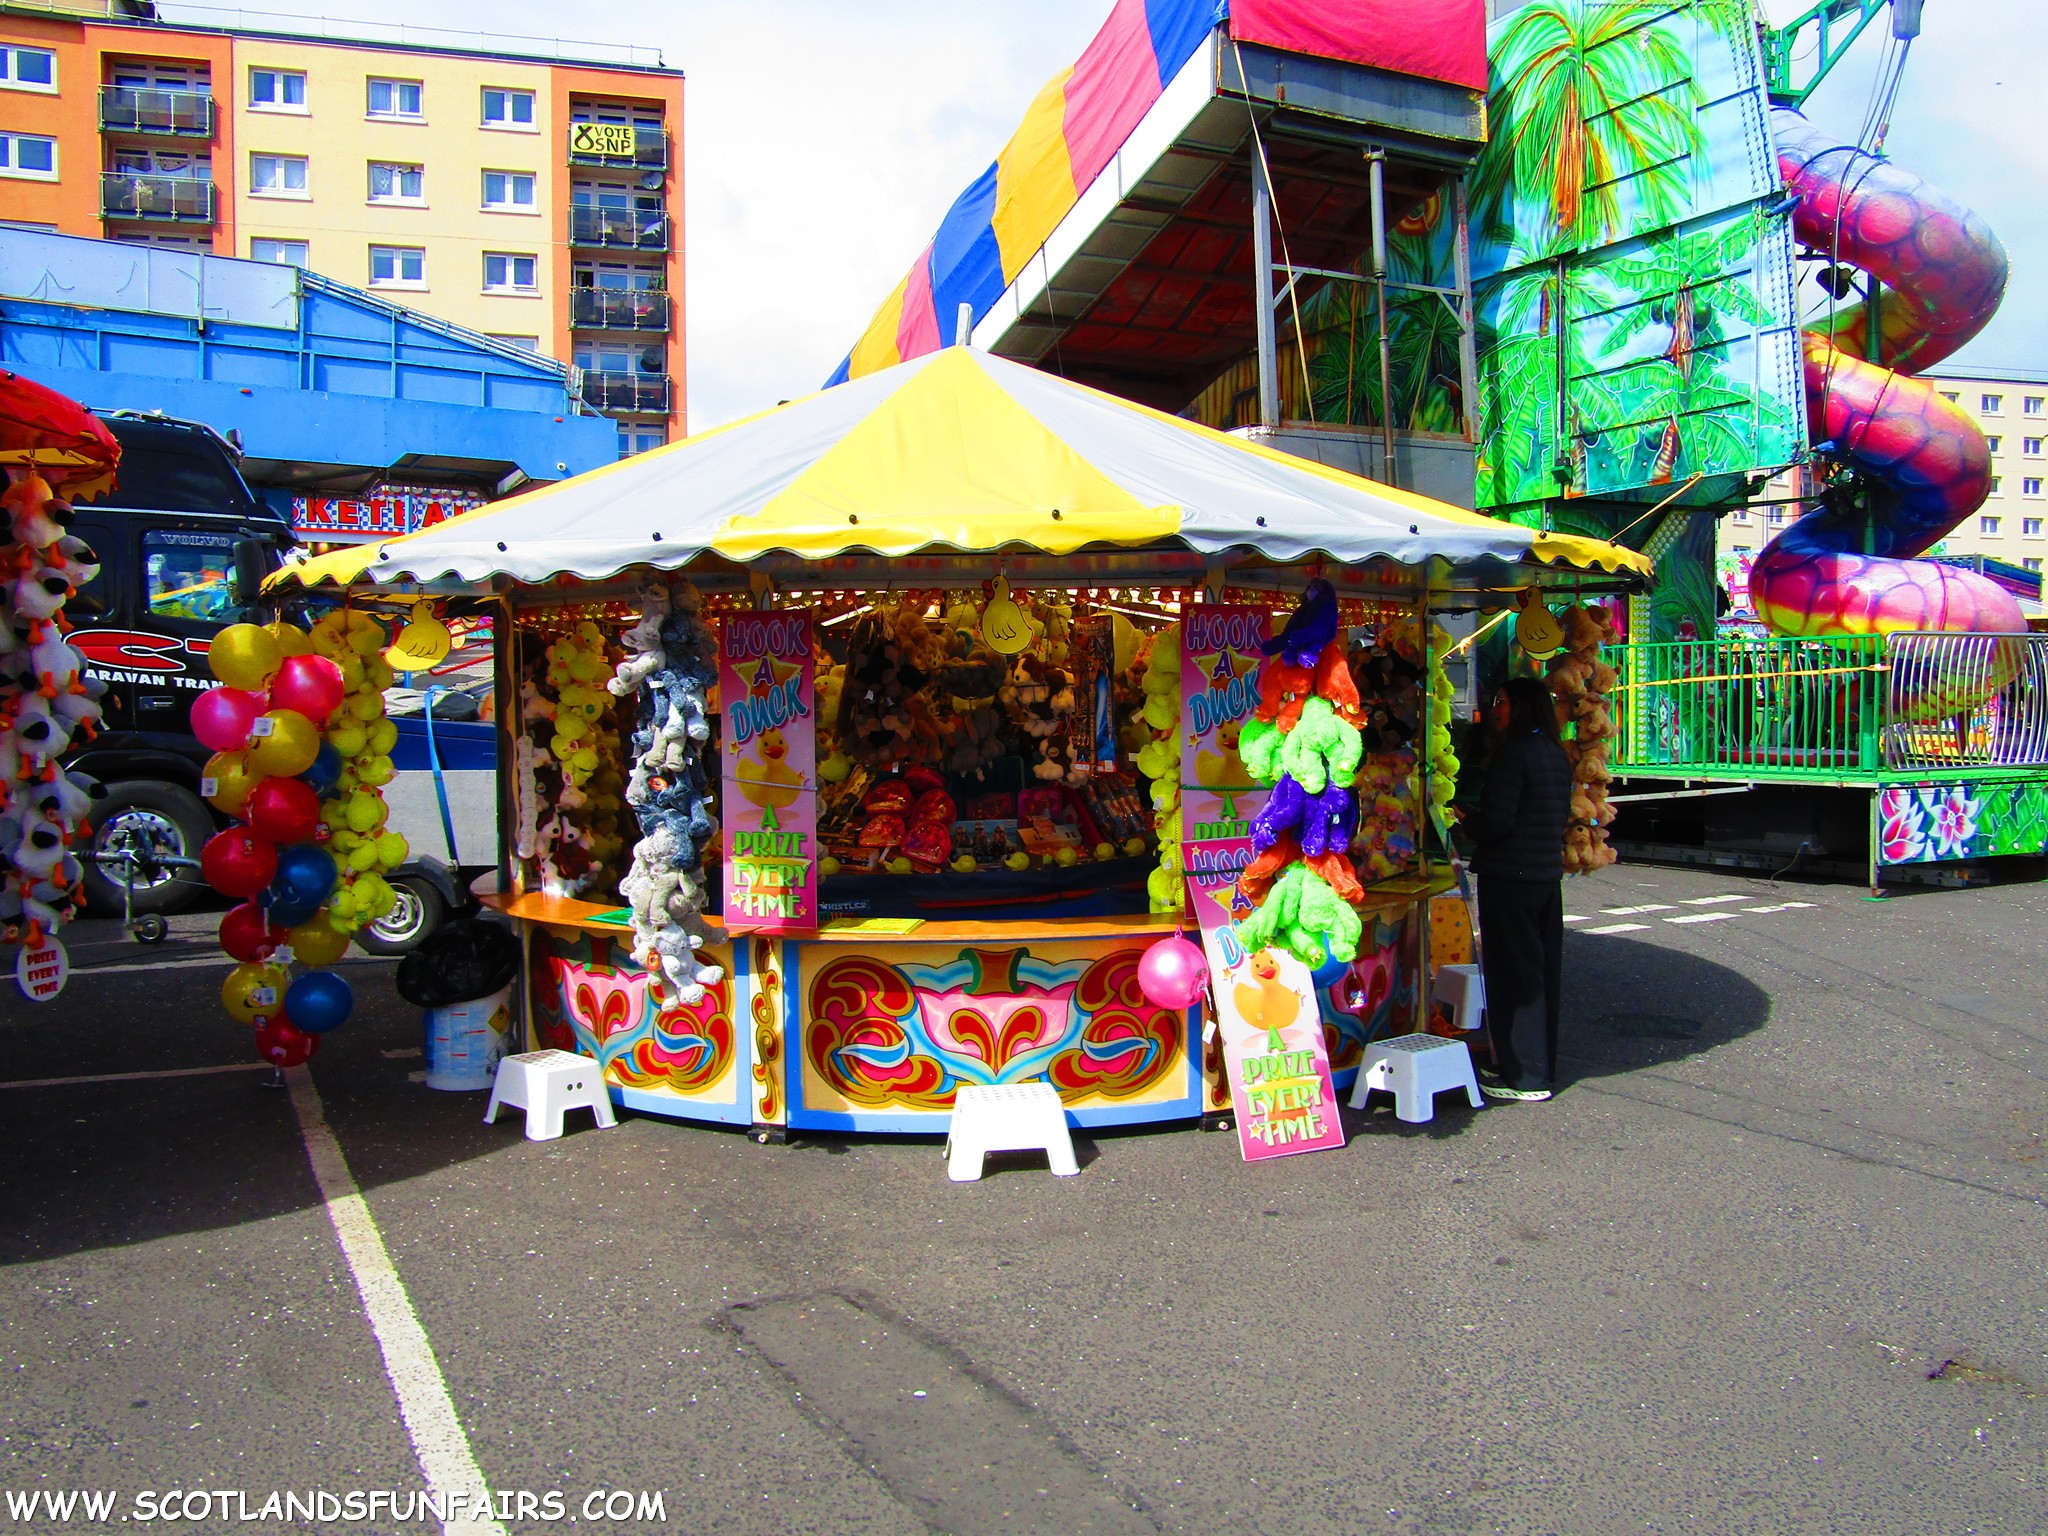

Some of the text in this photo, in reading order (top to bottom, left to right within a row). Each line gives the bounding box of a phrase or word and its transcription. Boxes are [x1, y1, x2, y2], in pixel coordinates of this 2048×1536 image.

[594, 126, 631, 139] VOTE
[595, 138, 631, 153] SNP
[161, 534, 230, 547] VOLVO
[725, 619, 808, 657] HOOK
[1186, 614, 1263, 650] HOOK
[752, 656, 774, 686] A
[1211, 649, 1233, 679] A
[728, 675, 808, 742] DUCK
[1187, 669, 1262, 735] DUCK
[760, 803, 779, 830] A
[1220, 793, 1239, 819] A
[734, 831, 807, 857] PRIZE
[733, 863, 809, 888] EVERY
[741, 893, 801, 918] TIME
[820, 901, 867, 911] WHISTLES
[26, 949, 57, 966] PRIZE
[27, 965, 59, 982] EVERY
[33, 980, 59, 996] TIME
[1267, 1024, 1287, 1053] A
[1242, 1049, 1318, 1085] PRIZE
[1246, 1080, 1323, 1117] EVERY
[1259, 1113, 1324, 1147] TIME
